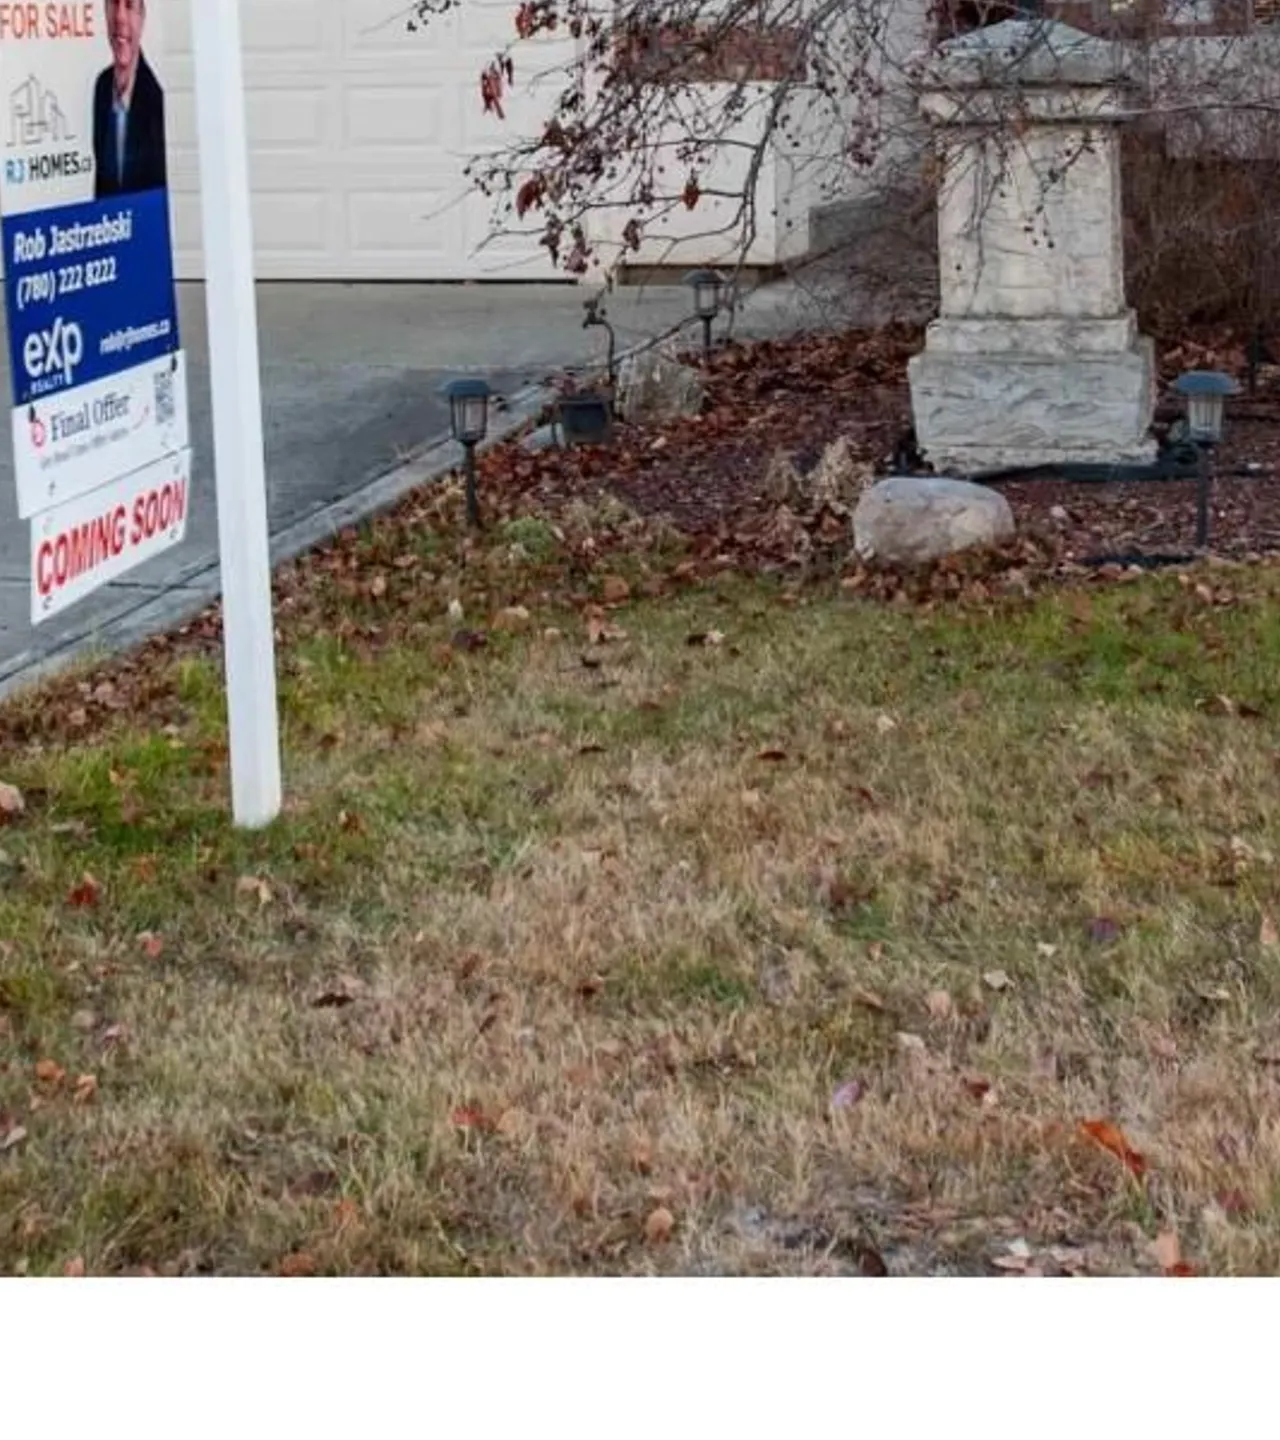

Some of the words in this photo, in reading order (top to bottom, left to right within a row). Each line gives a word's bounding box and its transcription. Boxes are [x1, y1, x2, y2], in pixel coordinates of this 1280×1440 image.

[46, 2, 95, 39] SALE
[13, 227, 46, 263] Rob
[16, 268, 57, 310] (780)
[58, 264, 84, 295] 222
[84, 256, 117, 289] 8222
[50, 401, 90, 442] Final
[92, 391, 131, 427] Offer
[36, 503, 126, 596] COMING
[130, 475, 186, 546] SOON
